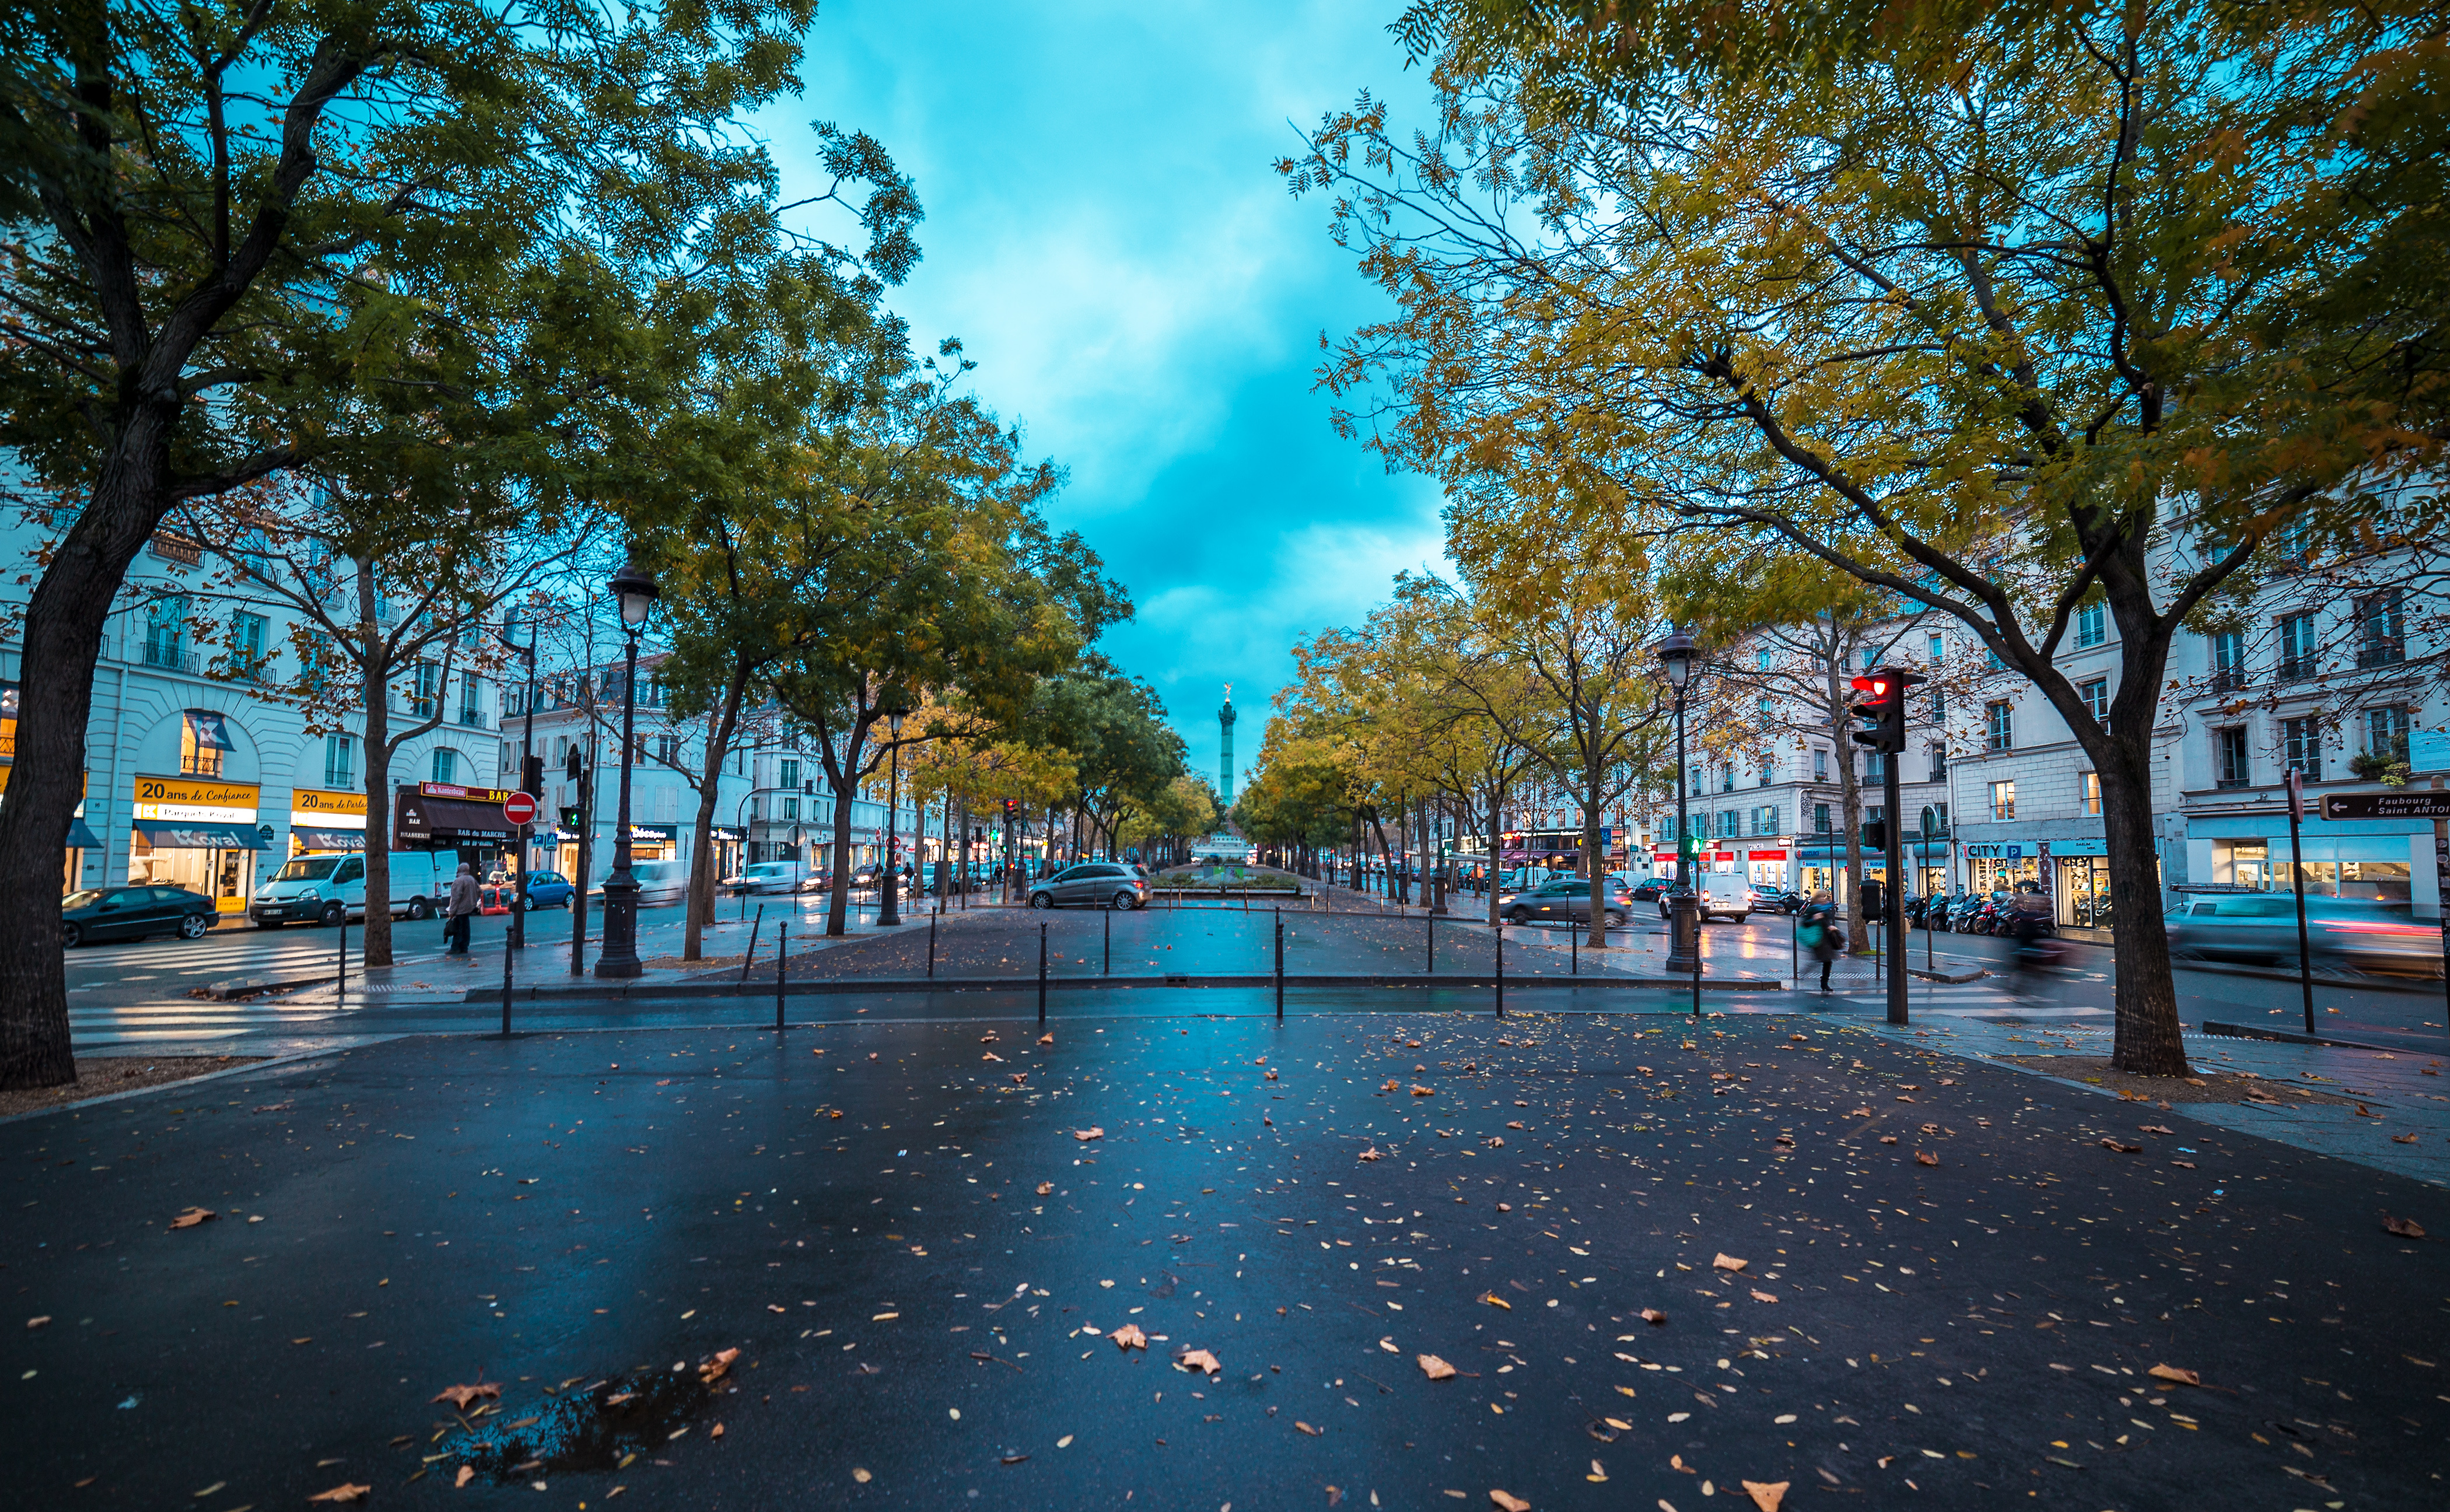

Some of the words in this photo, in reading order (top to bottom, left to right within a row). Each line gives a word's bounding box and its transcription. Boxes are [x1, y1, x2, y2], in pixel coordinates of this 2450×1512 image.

[142, 782, 165, 799] 20
[167, 792, 187, 800] ans
[191, 790, 204, 801] de
[206, 788, 252, 803] Confiance
[488, 790, 508, 801] BAR
[302, 794, 318, 808] 20
[336, 799, 345, 808] de
[2413, 806, 2450, 814] ANTOI
[170, 830, 243, 846] Koval
[1968, 845, 2001, 857] CITY
[2011, 848, 2018, 857] P
